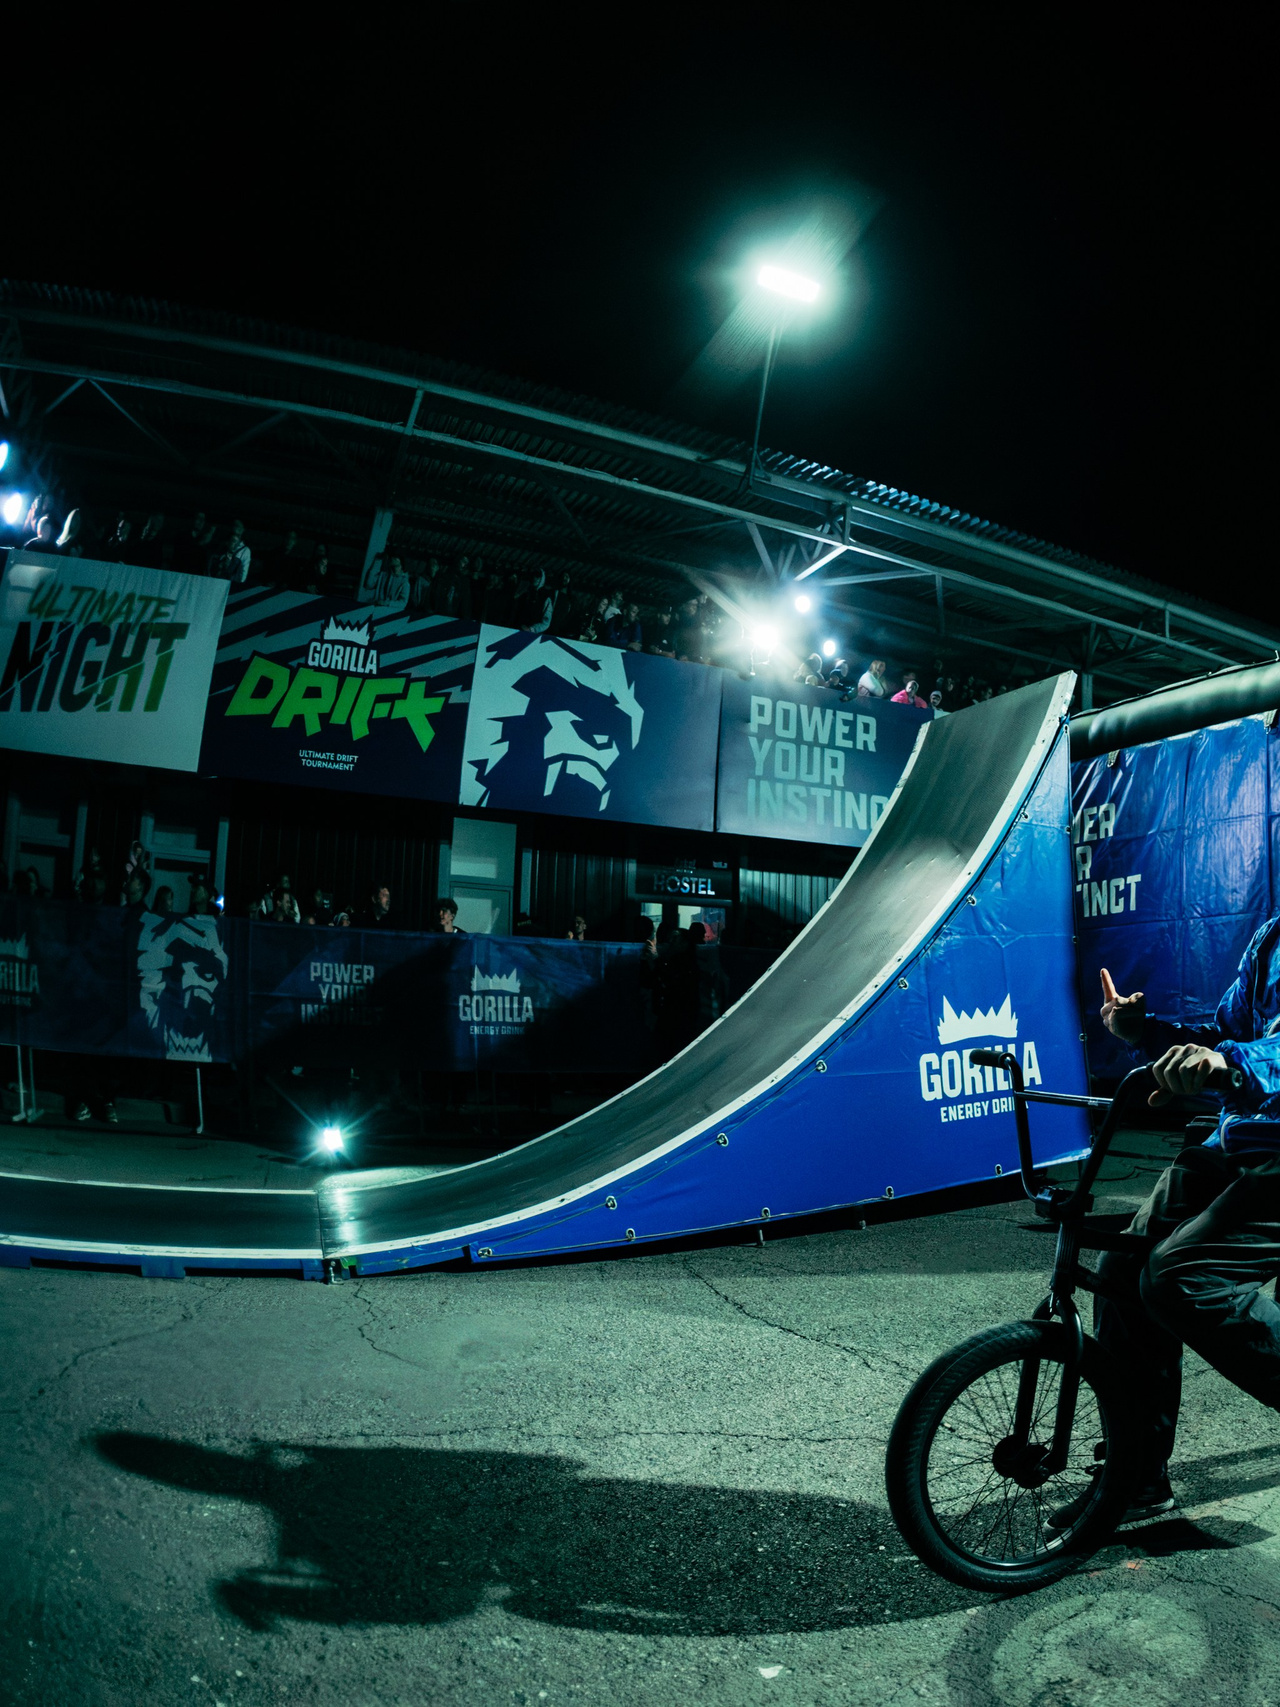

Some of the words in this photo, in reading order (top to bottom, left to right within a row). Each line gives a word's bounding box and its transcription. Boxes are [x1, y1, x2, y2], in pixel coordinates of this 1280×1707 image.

[27, 579, 178, 634] ULTIMATE
[0, 621, 191, 713] NIGHT
[307, 641, 378, 675] GORILLA
[751, 695, 877, 753] POWER
[299, 749, 335, 761] ULTIMATE
[336, 753, 359, 763] DRIFT
[301, 758, 355, 771] TOURNAMENT
[748, 736, 845, 787] YOUR
[747, 778, 890, 830] INSTINC
[653, 871, 716, 896] HOSTEL
[0, 961, 40, 993] RILLA
[310, 961, 375, 984] POWER
[459, 994, 535, 1023] GORILLA
[469, 1025, 500, 1036] ENERGY
[940, 1100, 990, 1123] ENERGY
[991, 1096, 1030, 1115] DRI
